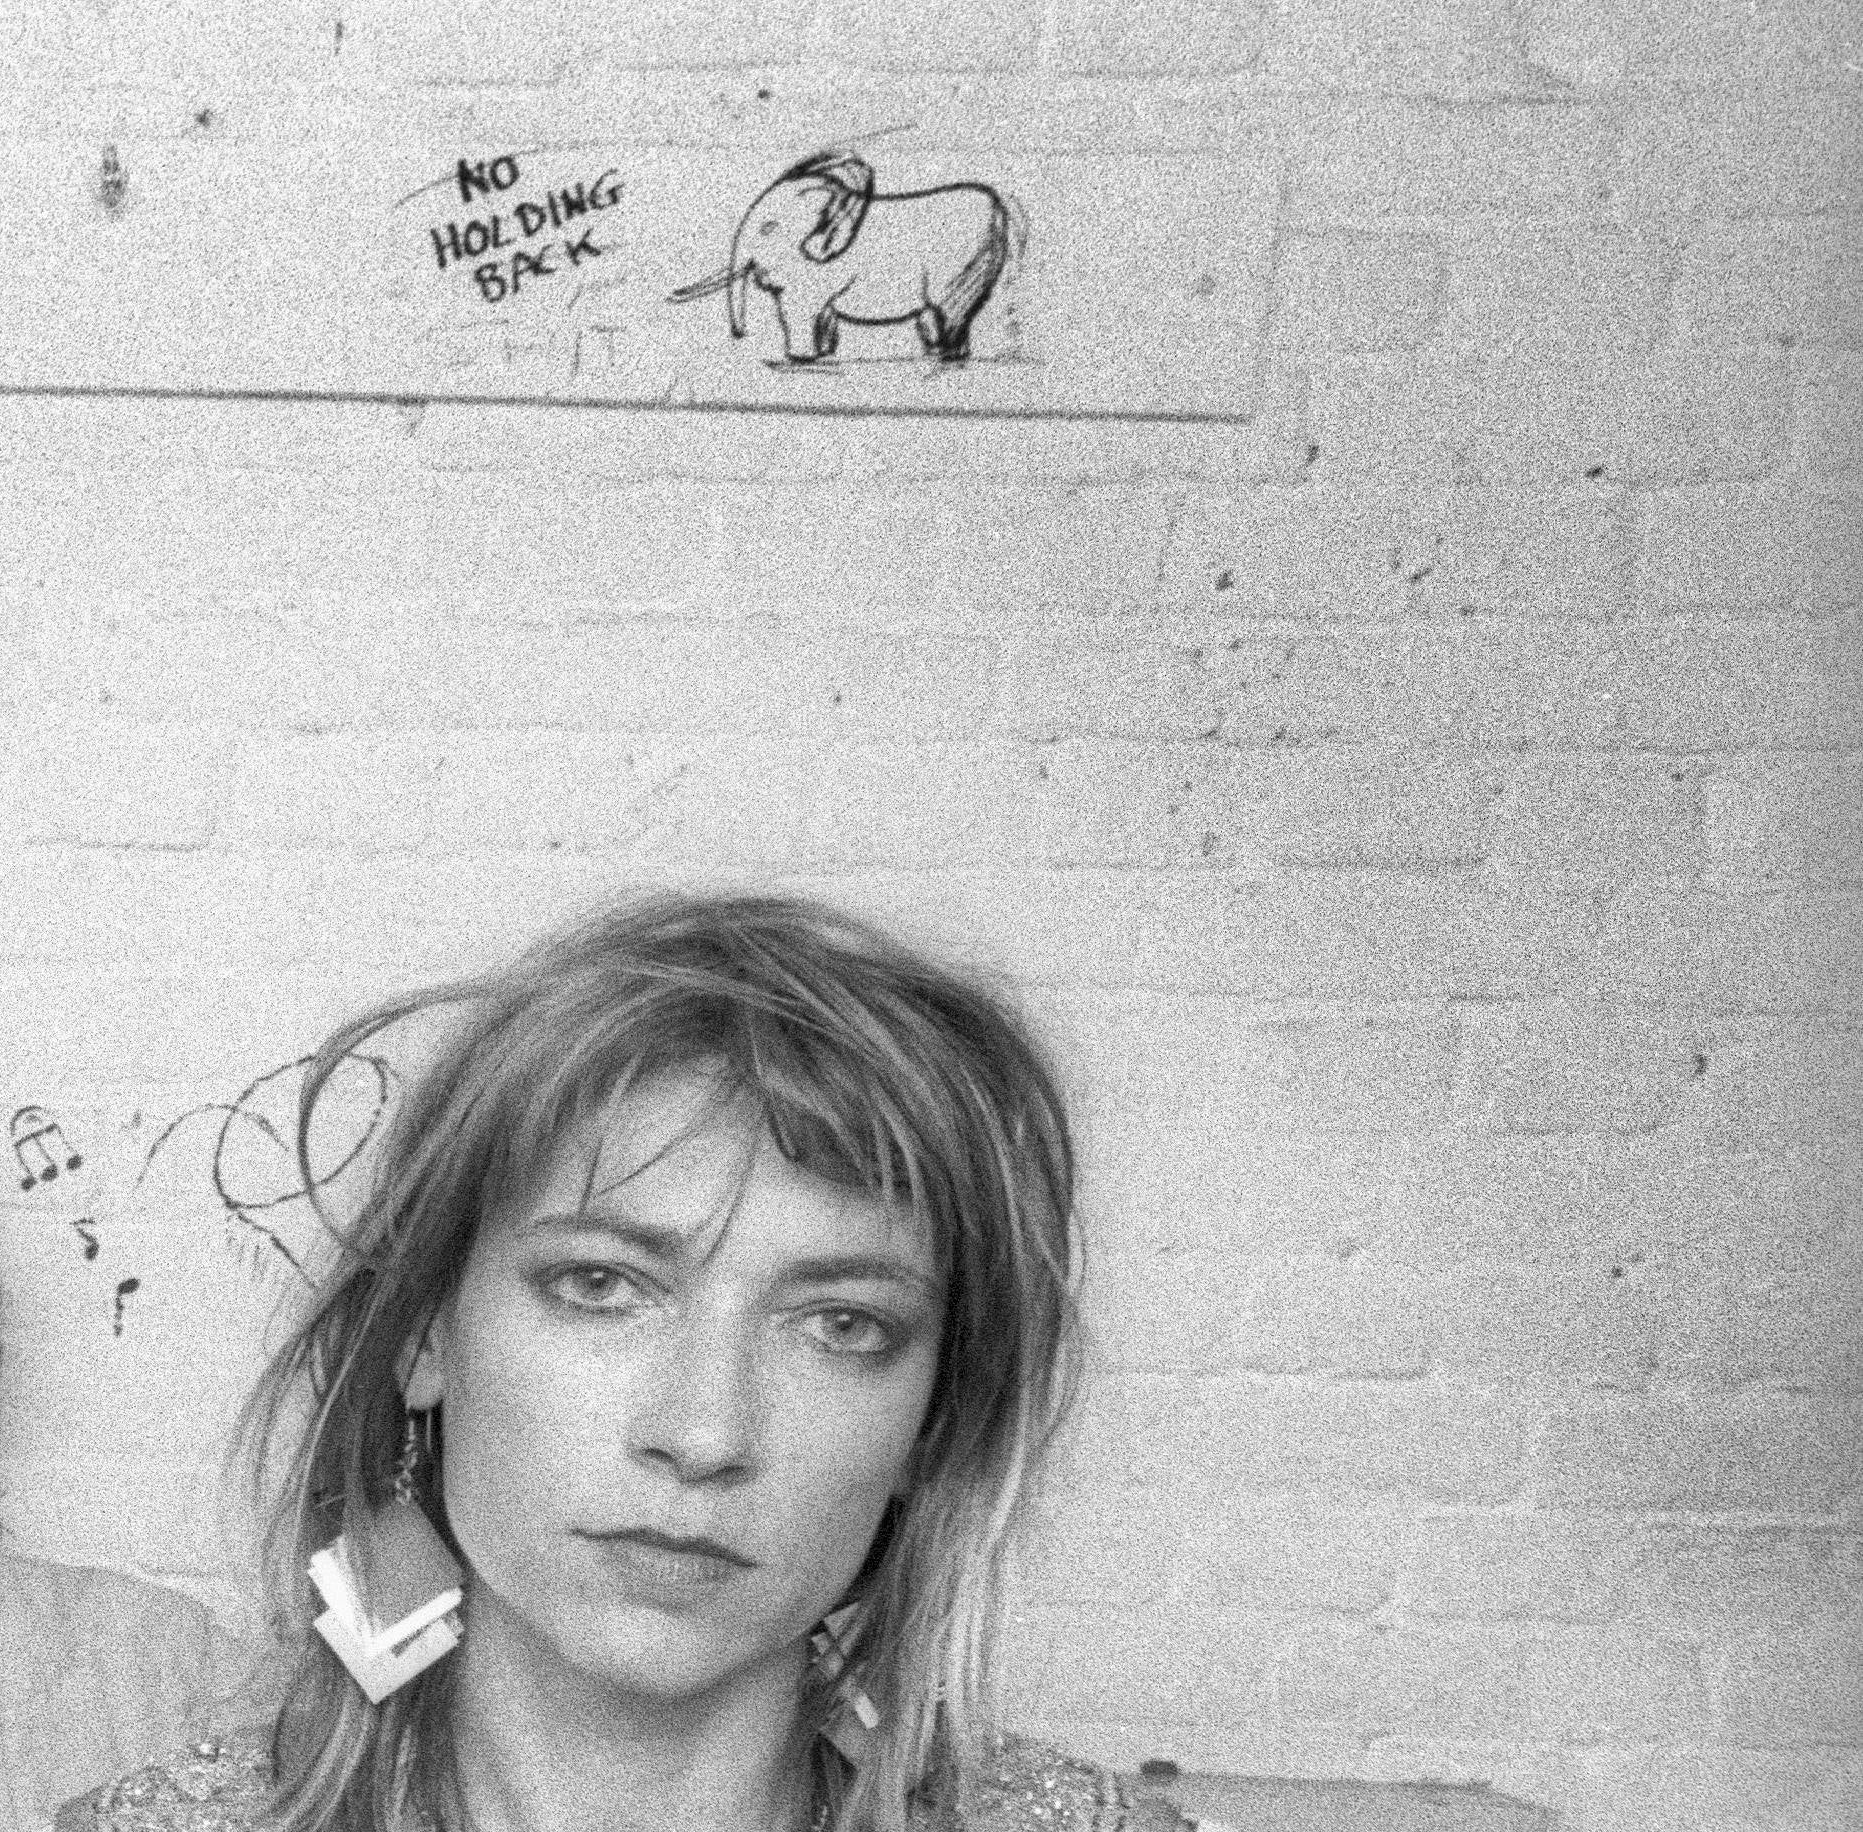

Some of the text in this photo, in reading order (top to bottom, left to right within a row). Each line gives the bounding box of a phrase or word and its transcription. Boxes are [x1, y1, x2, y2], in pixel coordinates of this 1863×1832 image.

[457, 154, 520, 204] NO
[430, 168, 625, 270] HOLDING
[473, 227, 602, 303] BACK
